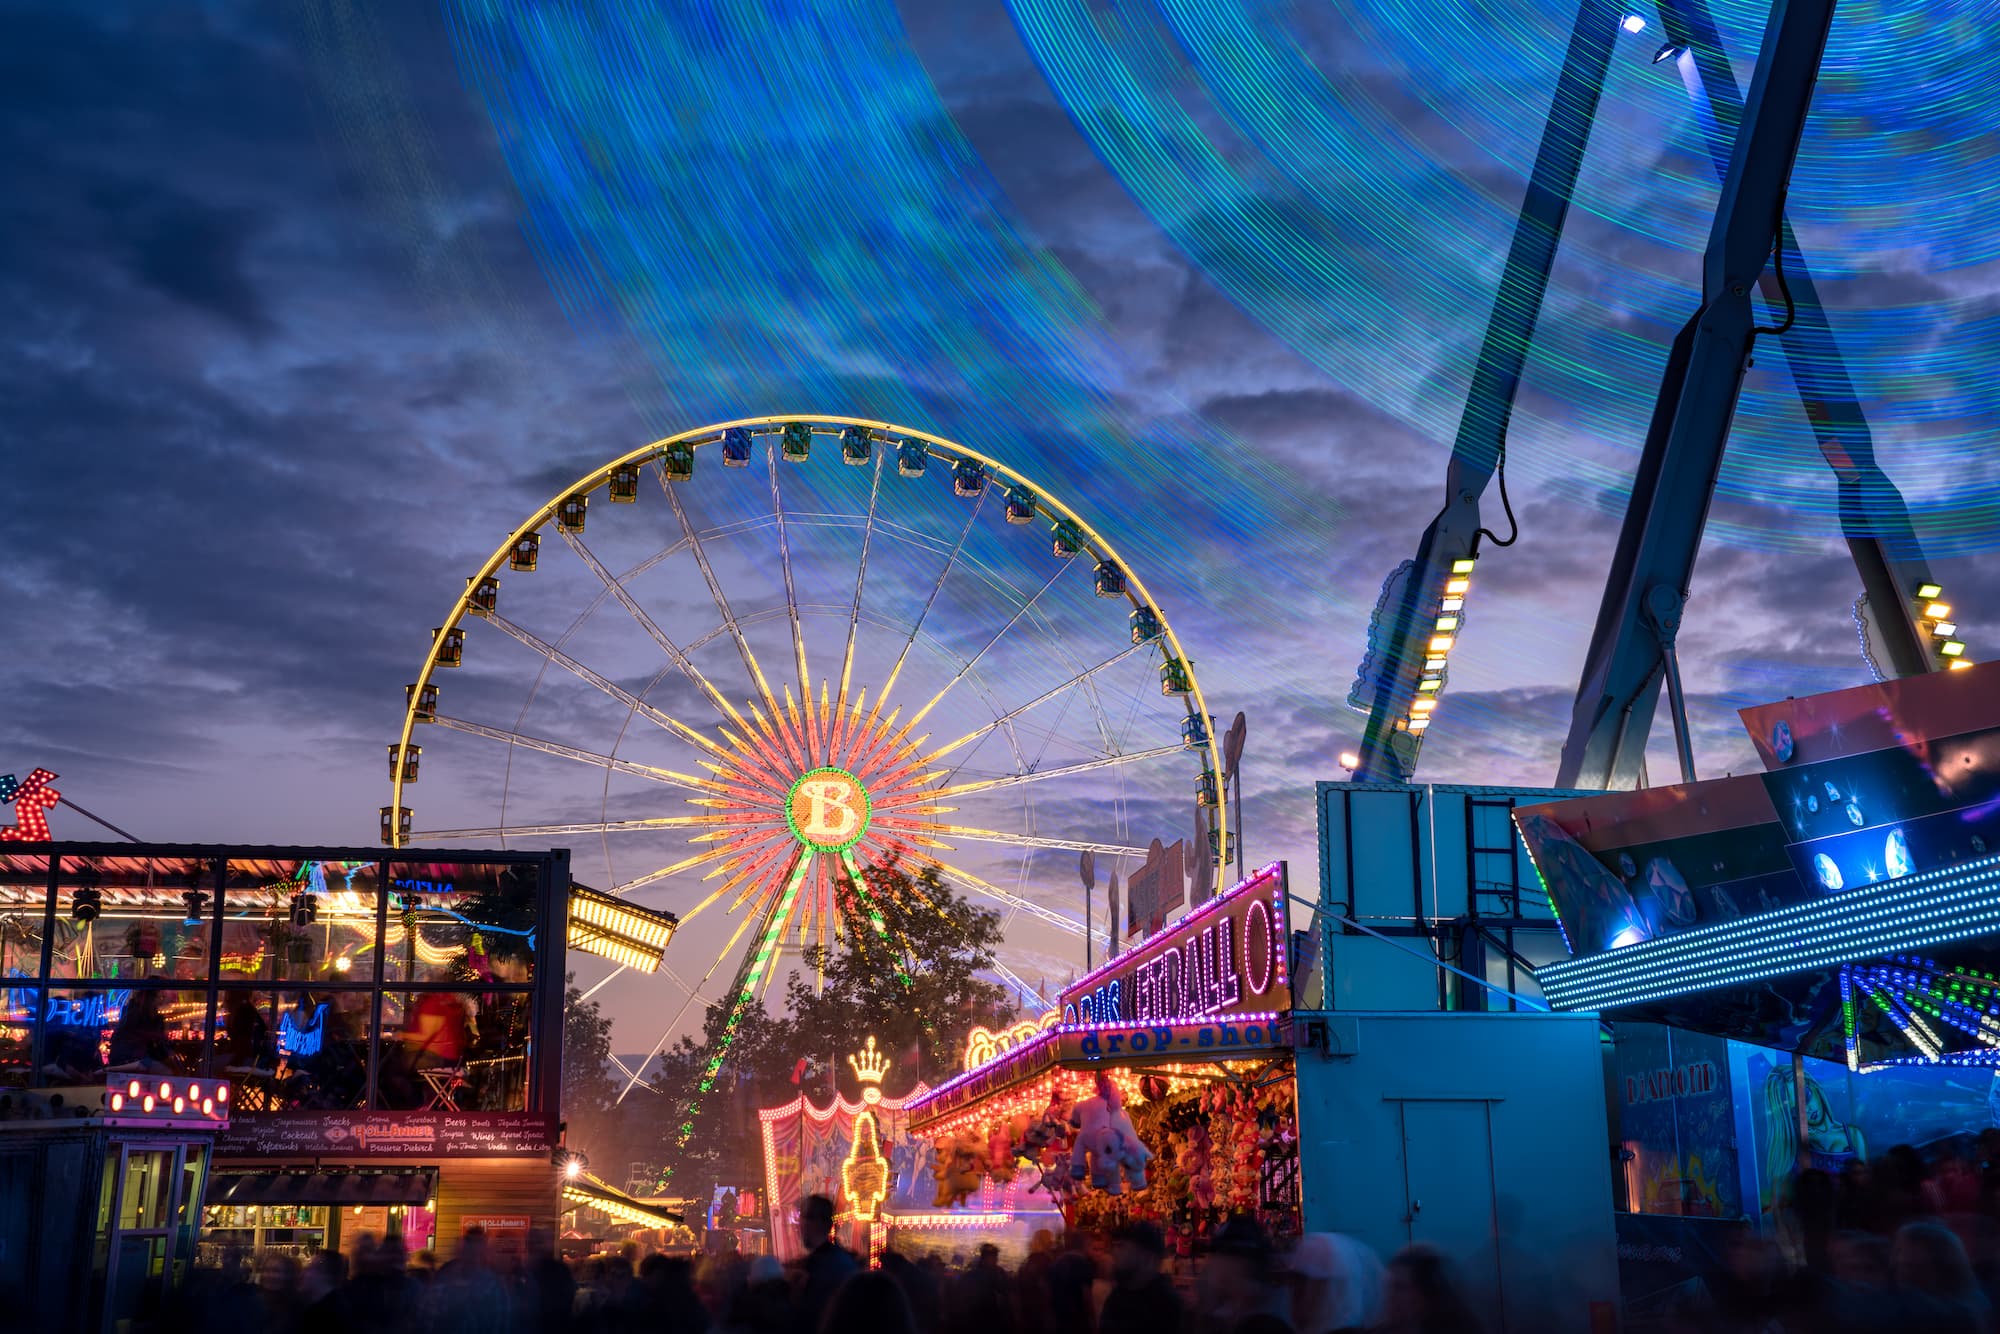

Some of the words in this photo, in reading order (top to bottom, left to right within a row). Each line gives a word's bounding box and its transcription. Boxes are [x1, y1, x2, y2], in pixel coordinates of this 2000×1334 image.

[801, 781, 858, 840] B
[1081, 1020, 1281, 1055] drop-shot
[322, 1115, 351, 1127] Snacks
[445, 1117, 466, 1127] Beers
[280, 1130, 318, 1140] Cocktails
[470, 1131, 496, 1141] Wines
[487, 1142, 508, 1151] Vodka
[515, 1143, 532, 1151] Cuba
